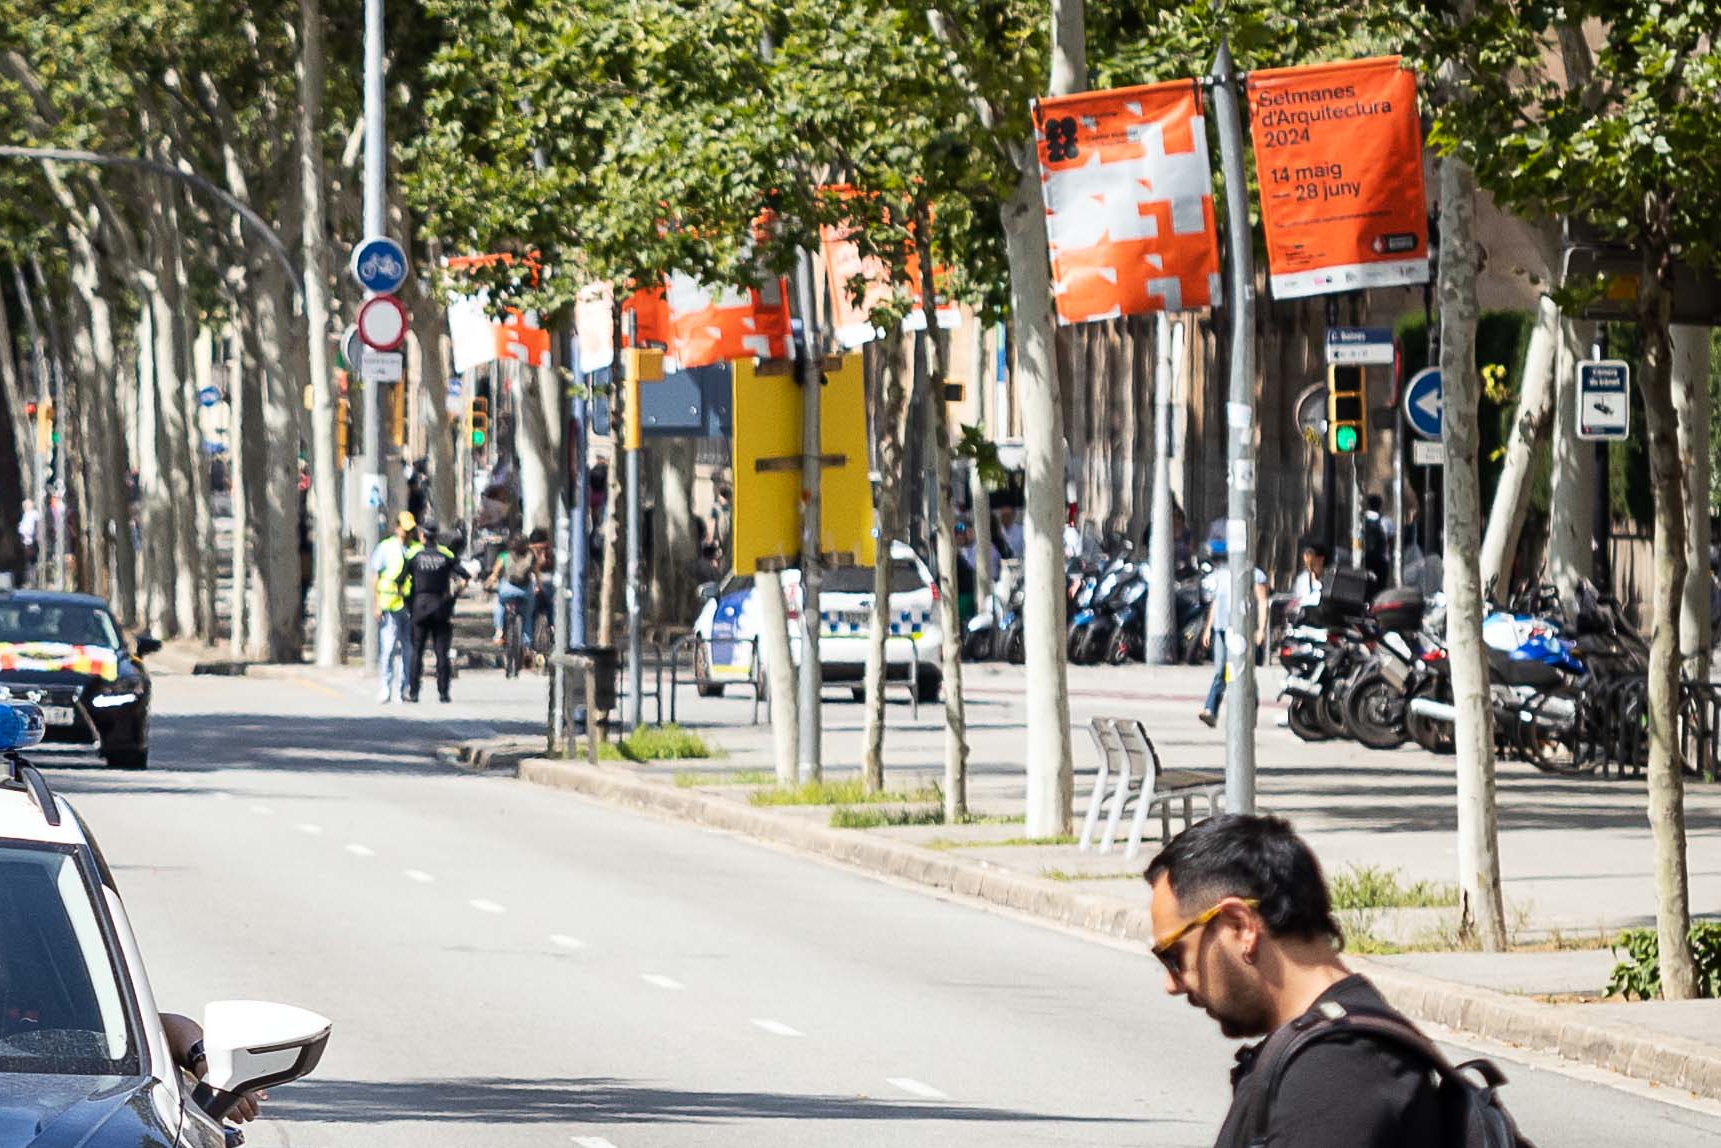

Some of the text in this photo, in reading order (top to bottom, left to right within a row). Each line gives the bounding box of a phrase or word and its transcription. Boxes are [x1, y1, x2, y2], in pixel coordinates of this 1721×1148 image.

[1259, 84, 1356, 108] Setmanes
[1261, 100, 1392, 128] d'Arquitectura
[1264, 128, 1311, 148] 2024
[1270, 162, 1343, 184] 14 maig
[1294, 182, 1318, 201] 28
[1321, 181, 1362, 201] juny
